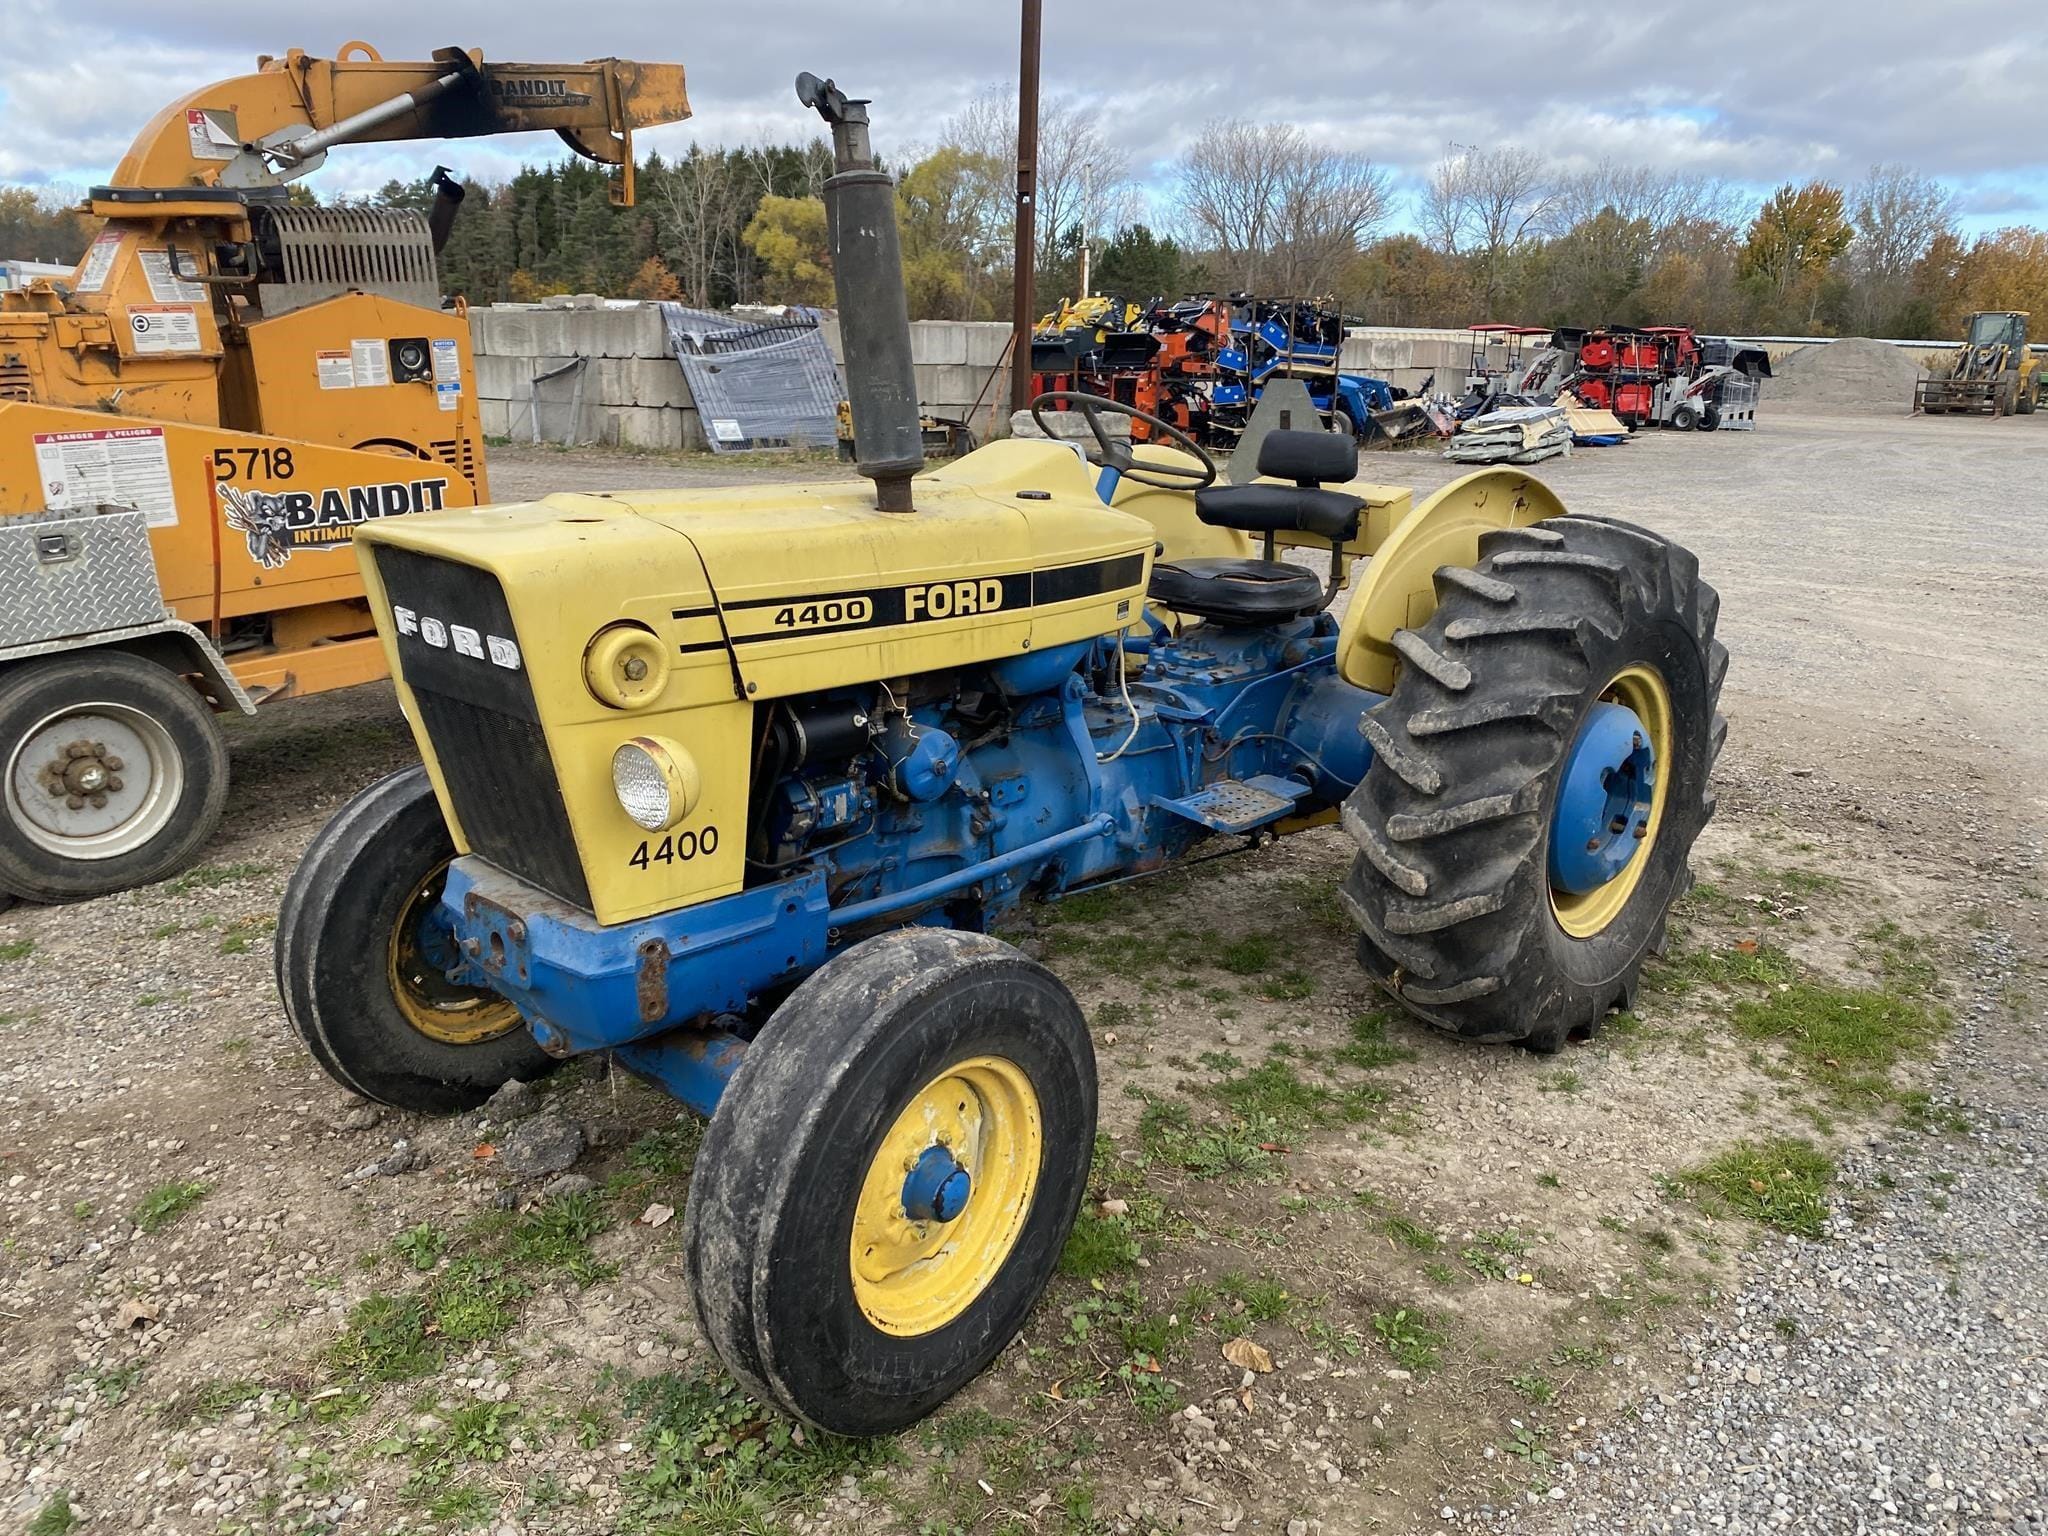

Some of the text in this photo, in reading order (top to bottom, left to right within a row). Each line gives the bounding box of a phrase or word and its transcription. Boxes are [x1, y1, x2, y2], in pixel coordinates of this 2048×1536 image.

[489, 79, 566, 96] BANDIT
[56, 432, 95, 440] DANGER
[115, 429, 152, 438] PELIGRO
[214, 448, 294, 481] 5718
[285, 479, 448, 528] BANDIT
[775, 579, 1003, 627] 4400 FORD
[394, 605, 521, 671] FORD
[629, 826, 719, 870] 4400
